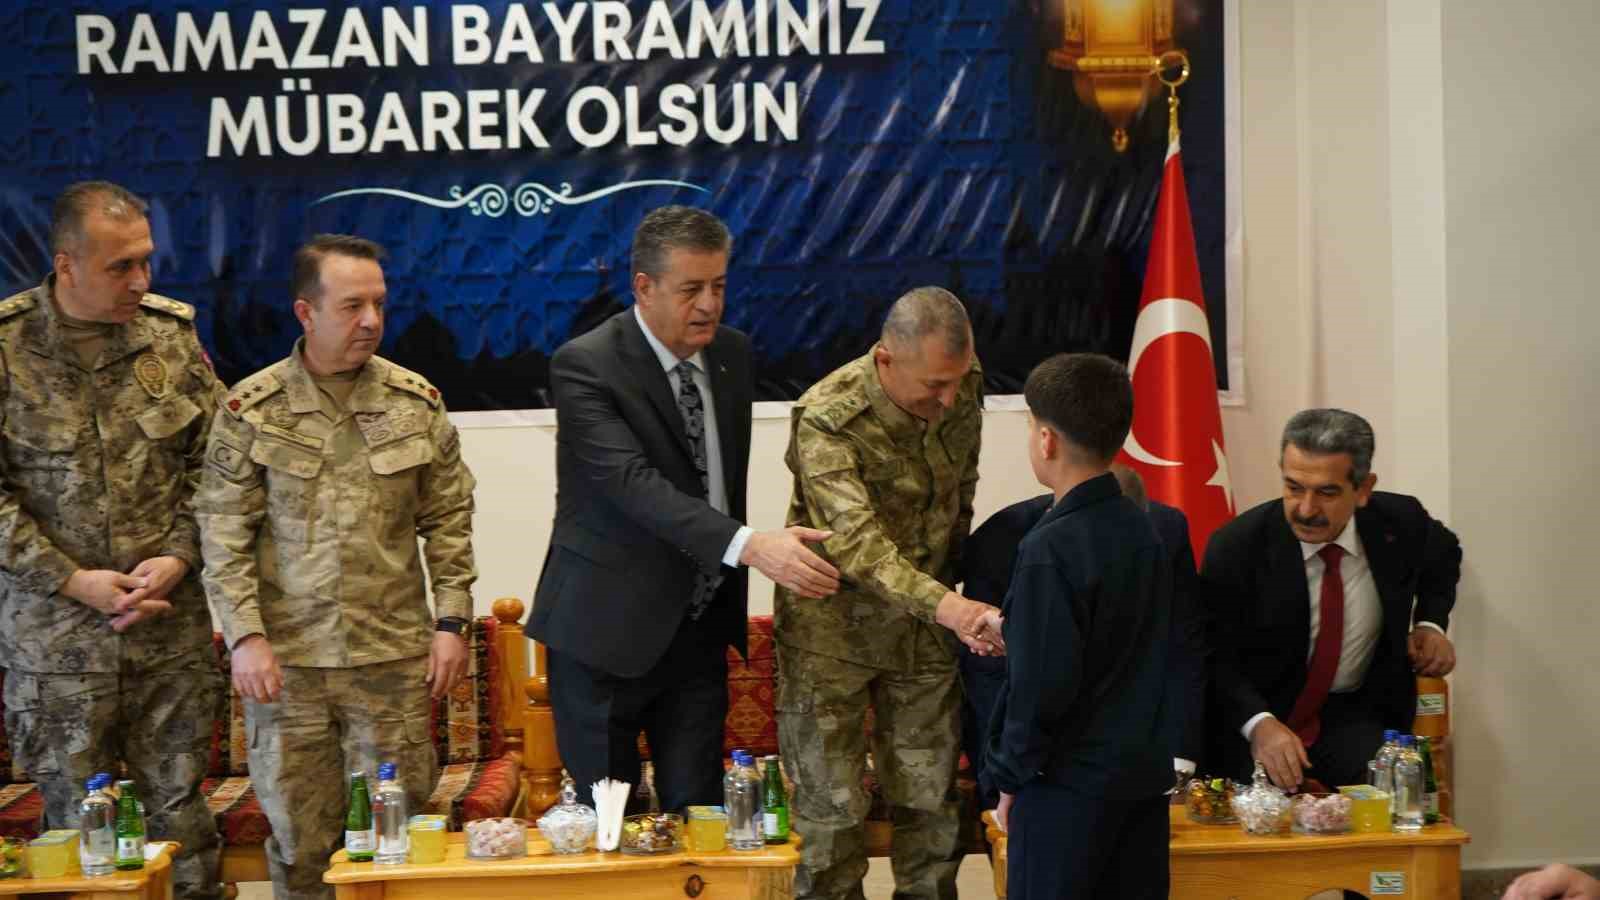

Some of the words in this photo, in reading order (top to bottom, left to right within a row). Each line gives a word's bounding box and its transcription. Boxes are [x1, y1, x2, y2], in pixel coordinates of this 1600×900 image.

[76, 7, 430, 74] RAMAZAN
[452, 0, 885, 65] BAYRAMINIZ
[207, 78, 550, 157] MÜBAREK
[566, 81, 799, 147] OLSUN
